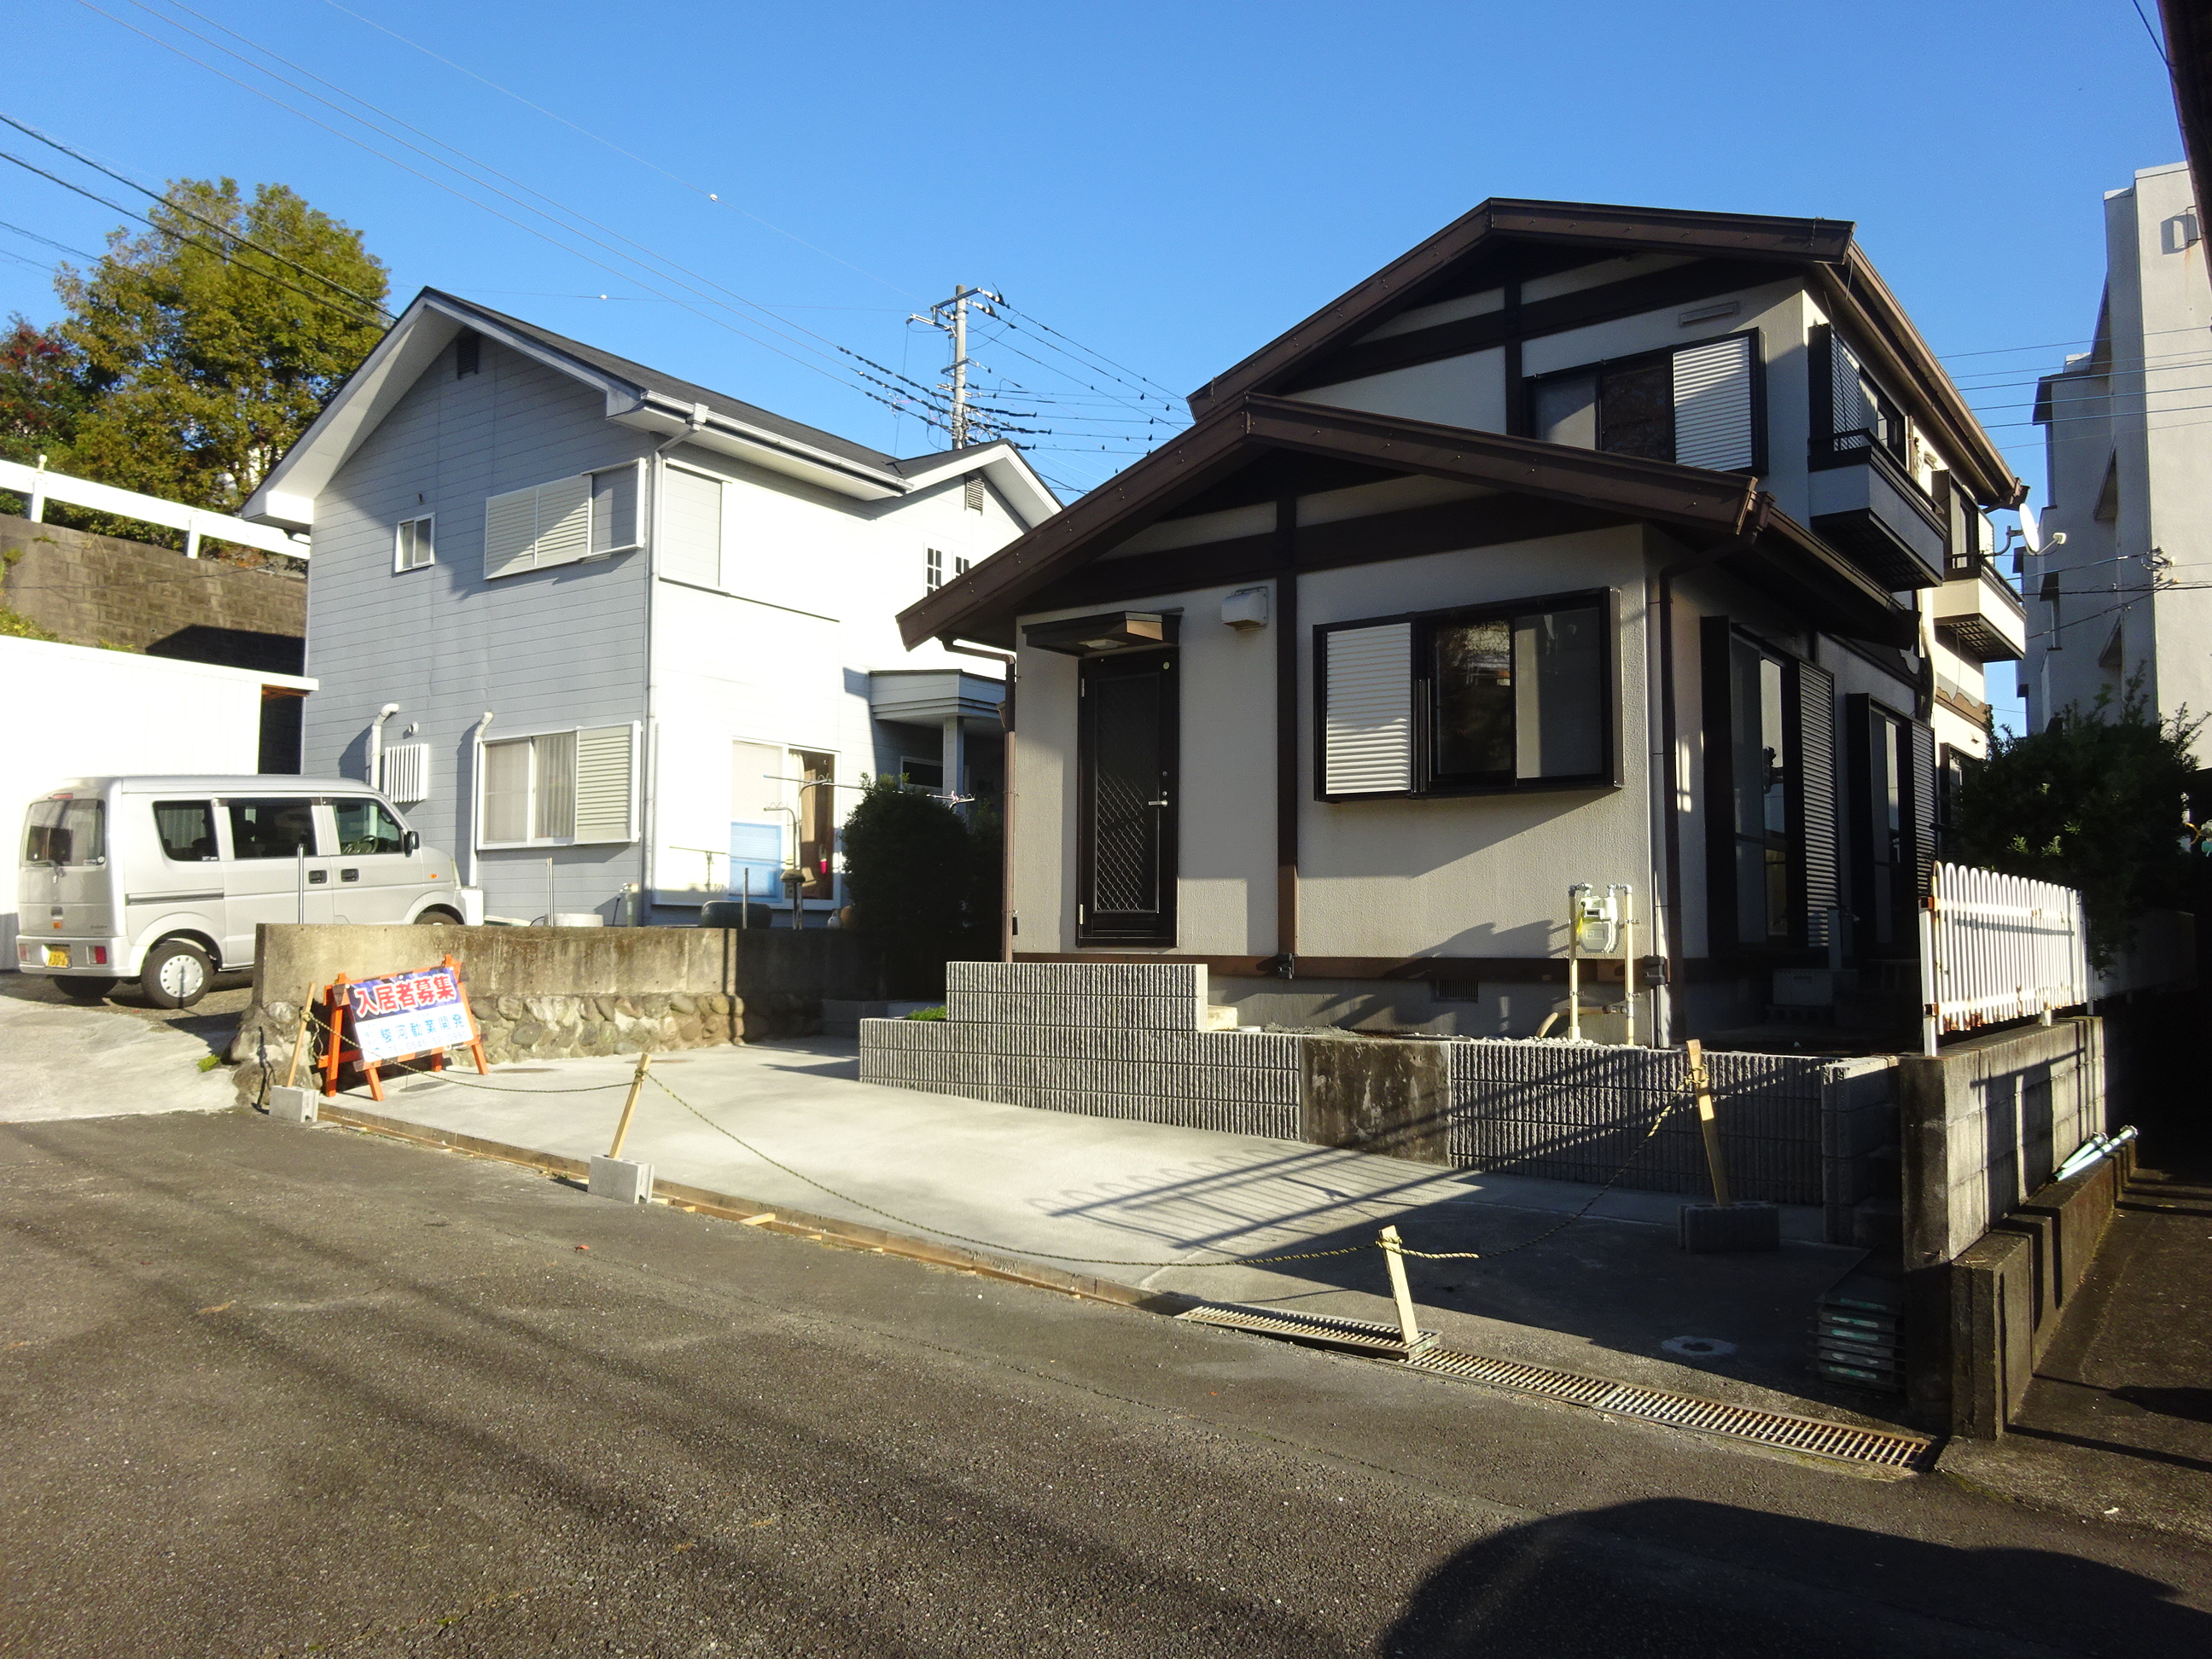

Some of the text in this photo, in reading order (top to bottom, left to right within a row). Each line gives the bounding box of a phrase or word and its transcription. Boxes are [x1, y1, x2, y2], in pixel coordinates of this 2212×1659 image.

[355, 974, 457, 1017] 入居者募集
